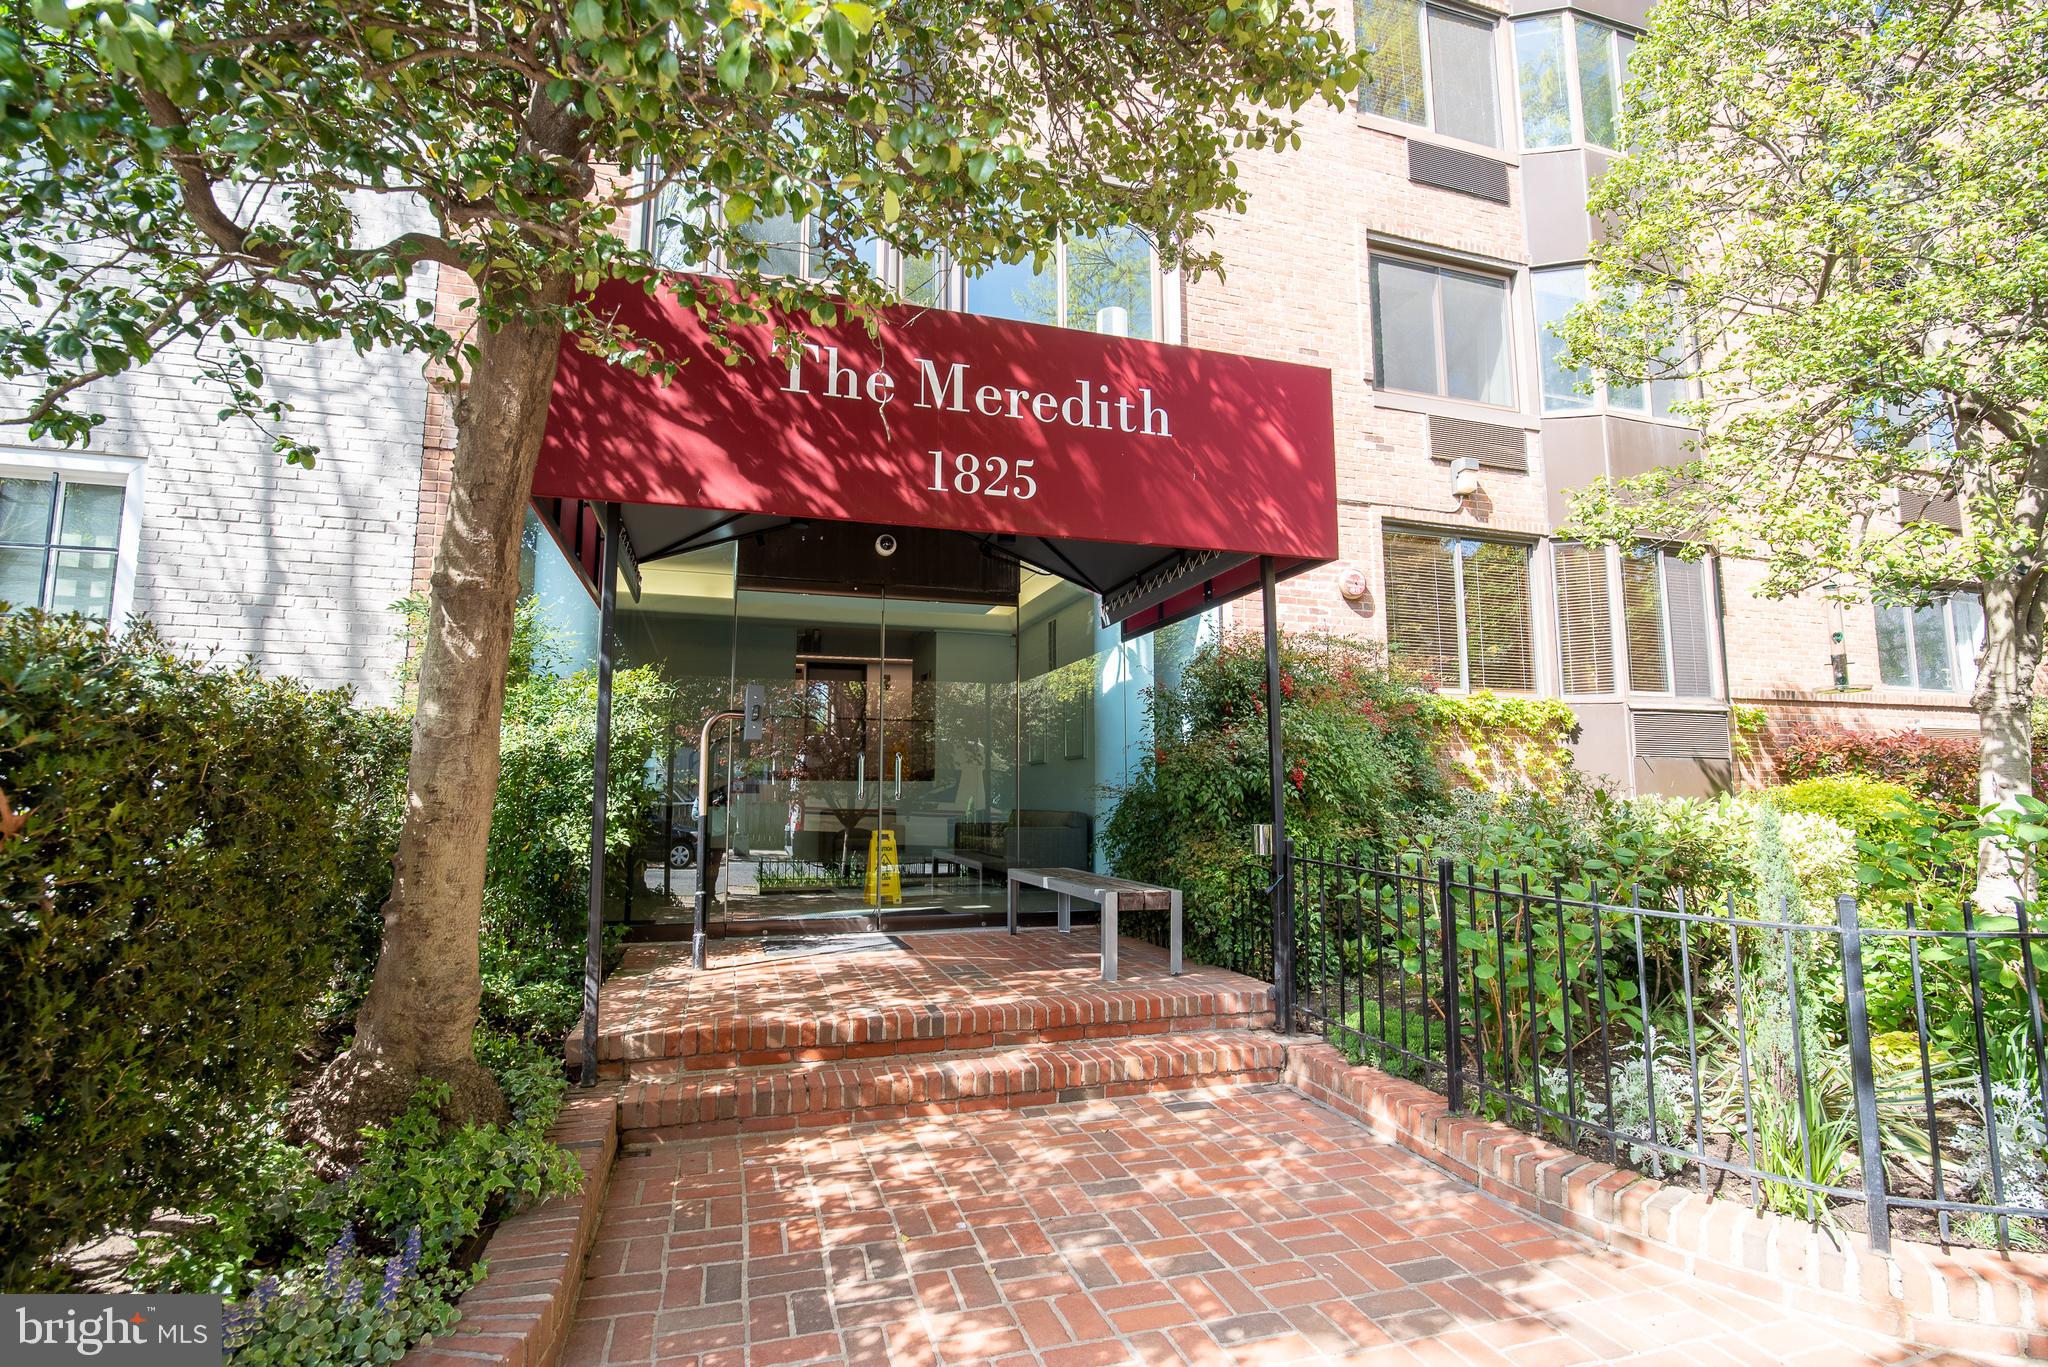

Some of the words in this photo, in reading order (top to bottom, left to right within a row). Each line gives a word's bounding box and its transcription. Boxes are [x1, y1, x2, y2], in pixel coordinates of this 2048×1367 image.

[771, 337, 895, 404] The
[913, 357, 1173, 437] Meredith
[927, 450, 1037, 499] 1825
